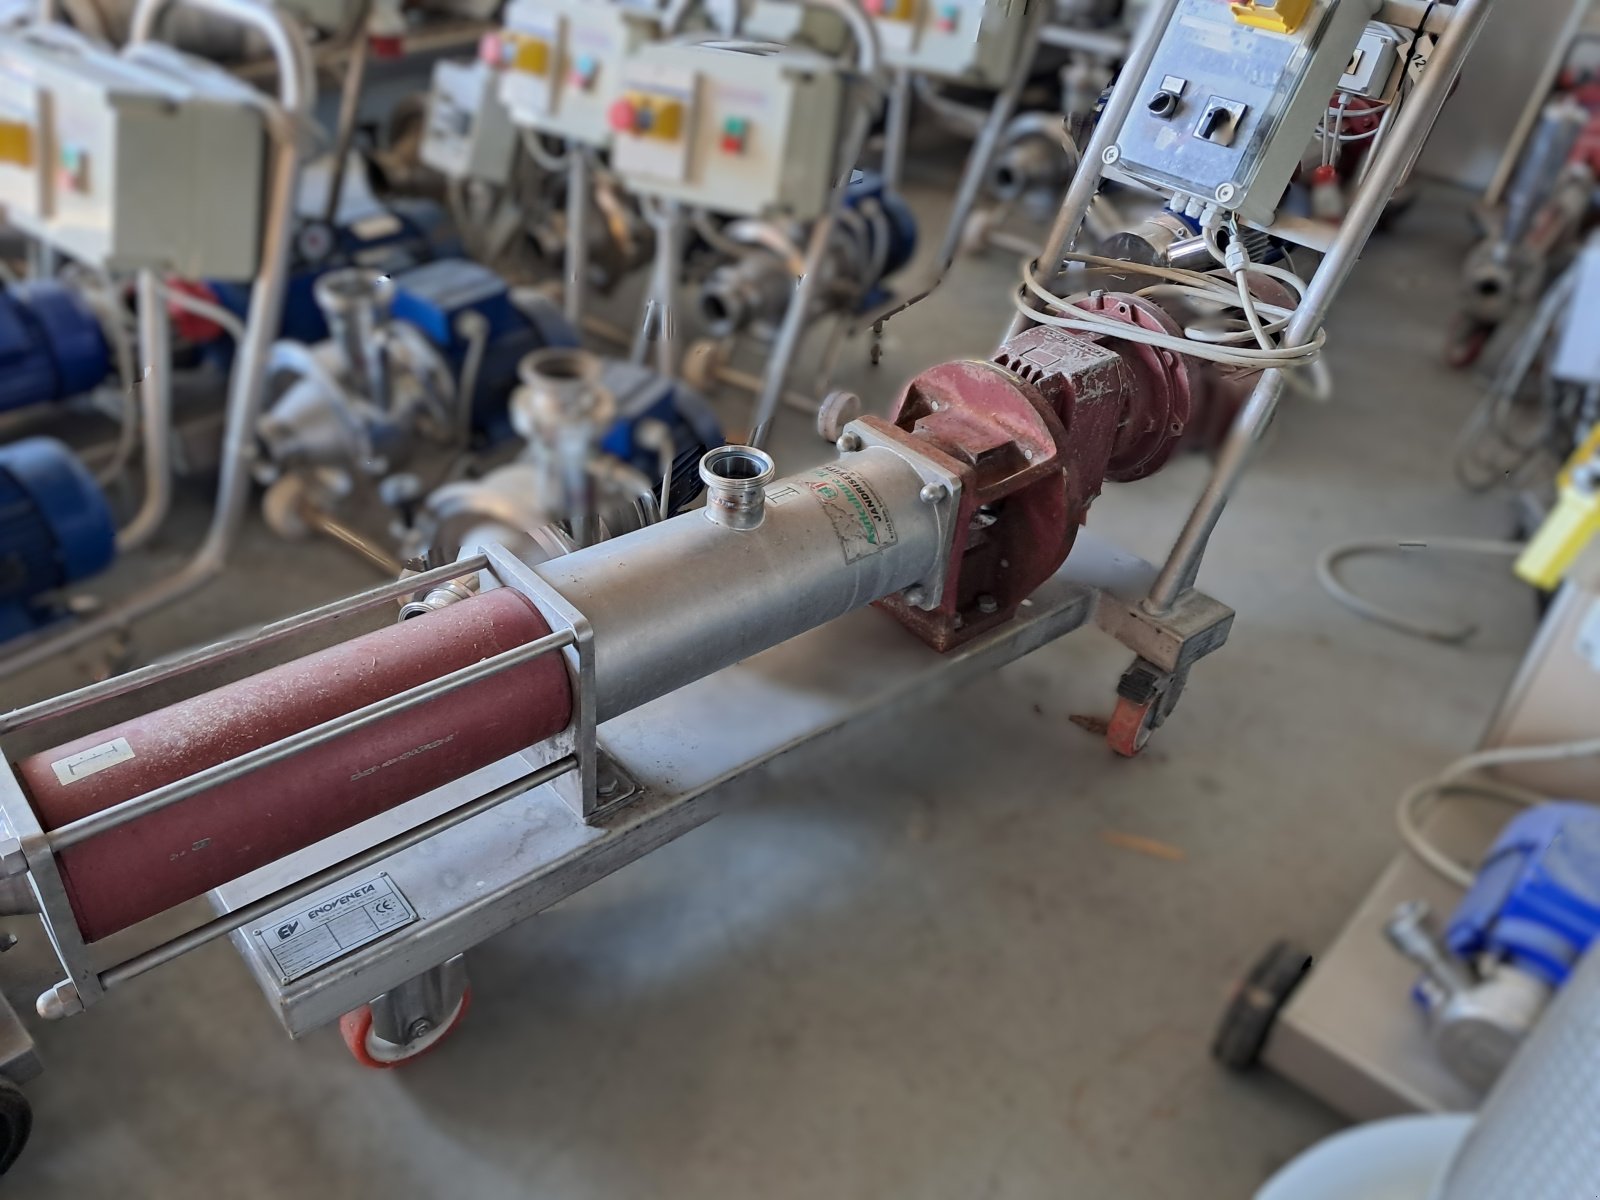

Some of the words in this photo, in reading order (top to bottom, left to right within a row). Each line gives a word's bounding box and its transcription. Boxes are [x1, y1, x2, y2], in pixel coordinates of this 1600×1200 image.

[307, 884, 376, 920] ENOVENETA
[375, 900, 393, 914] CE
[277, 920, 299, 940] EV
